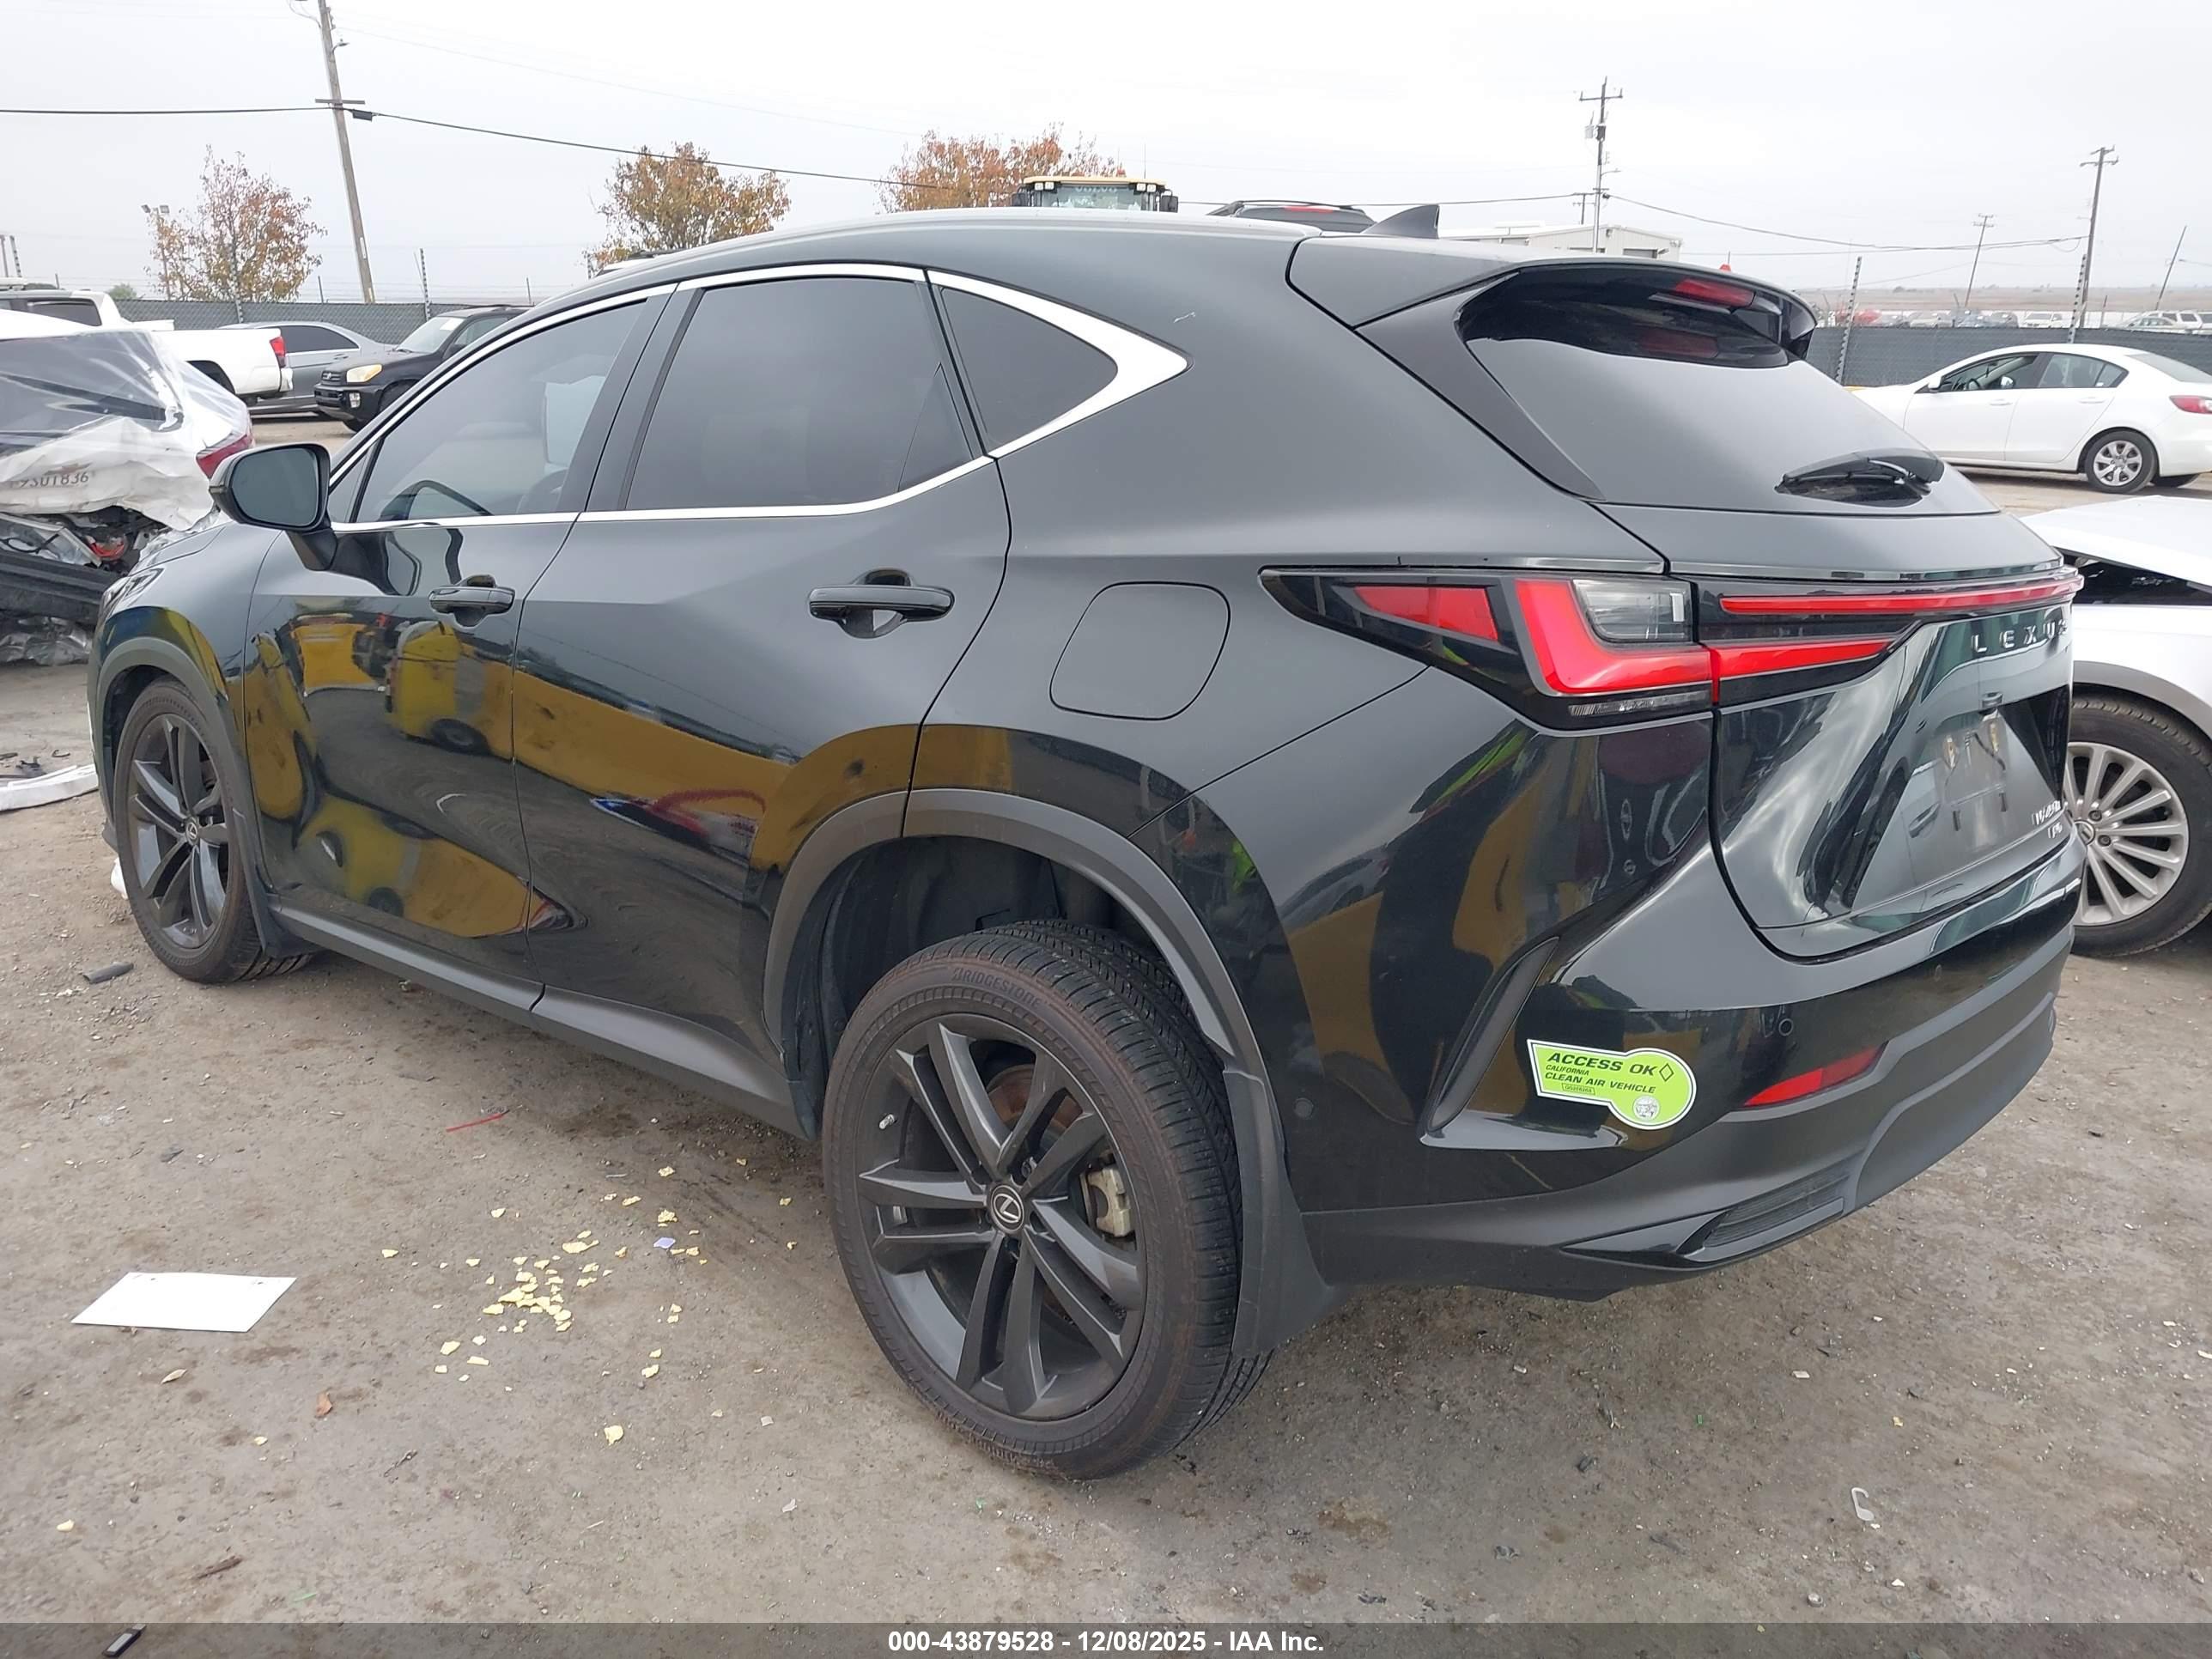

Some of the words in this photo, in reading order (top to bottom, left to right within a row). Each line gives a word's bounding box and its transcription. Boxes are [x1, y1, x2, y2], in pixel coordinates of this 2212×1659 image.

[1971, 618, 2069, 653] LEXUS
[951, 967, 1041, 1008] BRIDGESTONE
[1545, 1064, 1590, 1076] CALIFORNIA
[1547, 1052, 1624, 1072] ACCESS
[1629, 1063, 1658, 1076] OK
[1545, 1072, 1583, 1084] CLEAN
[1585, 1078, 1606, 1087] AIR
[1610, 1080, 1656, 1094] VEHICLE
